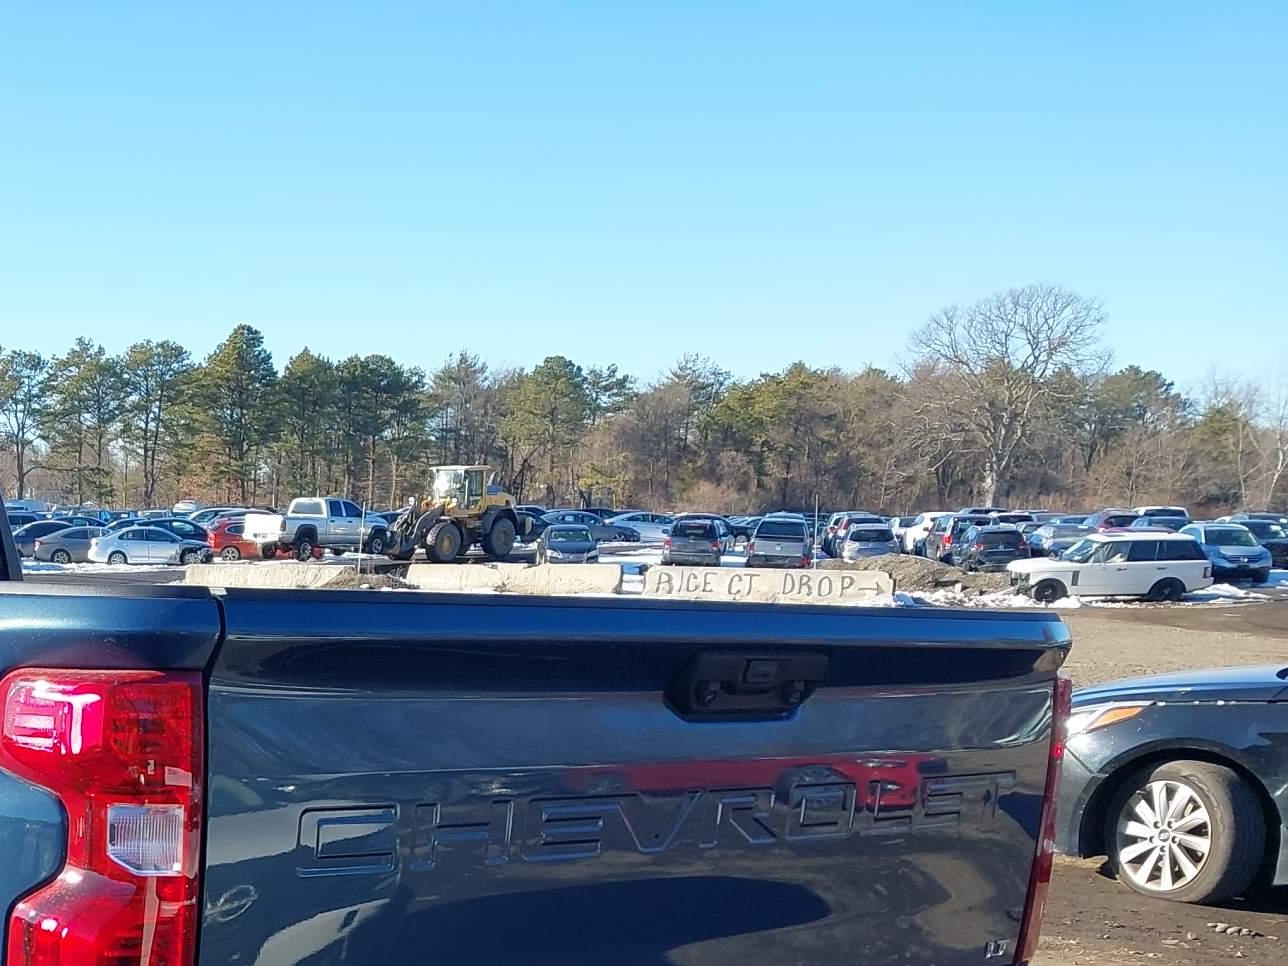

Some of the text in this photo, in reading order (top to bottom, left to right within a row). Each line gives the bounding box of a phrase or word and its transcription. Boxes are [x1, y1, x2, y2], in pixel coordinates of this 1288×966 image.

[655, 571, 856, 598] RICE CT DROP
[296, 770, 1017, 878] CHEVROLET
[984, 939, 1010, 959] LT
